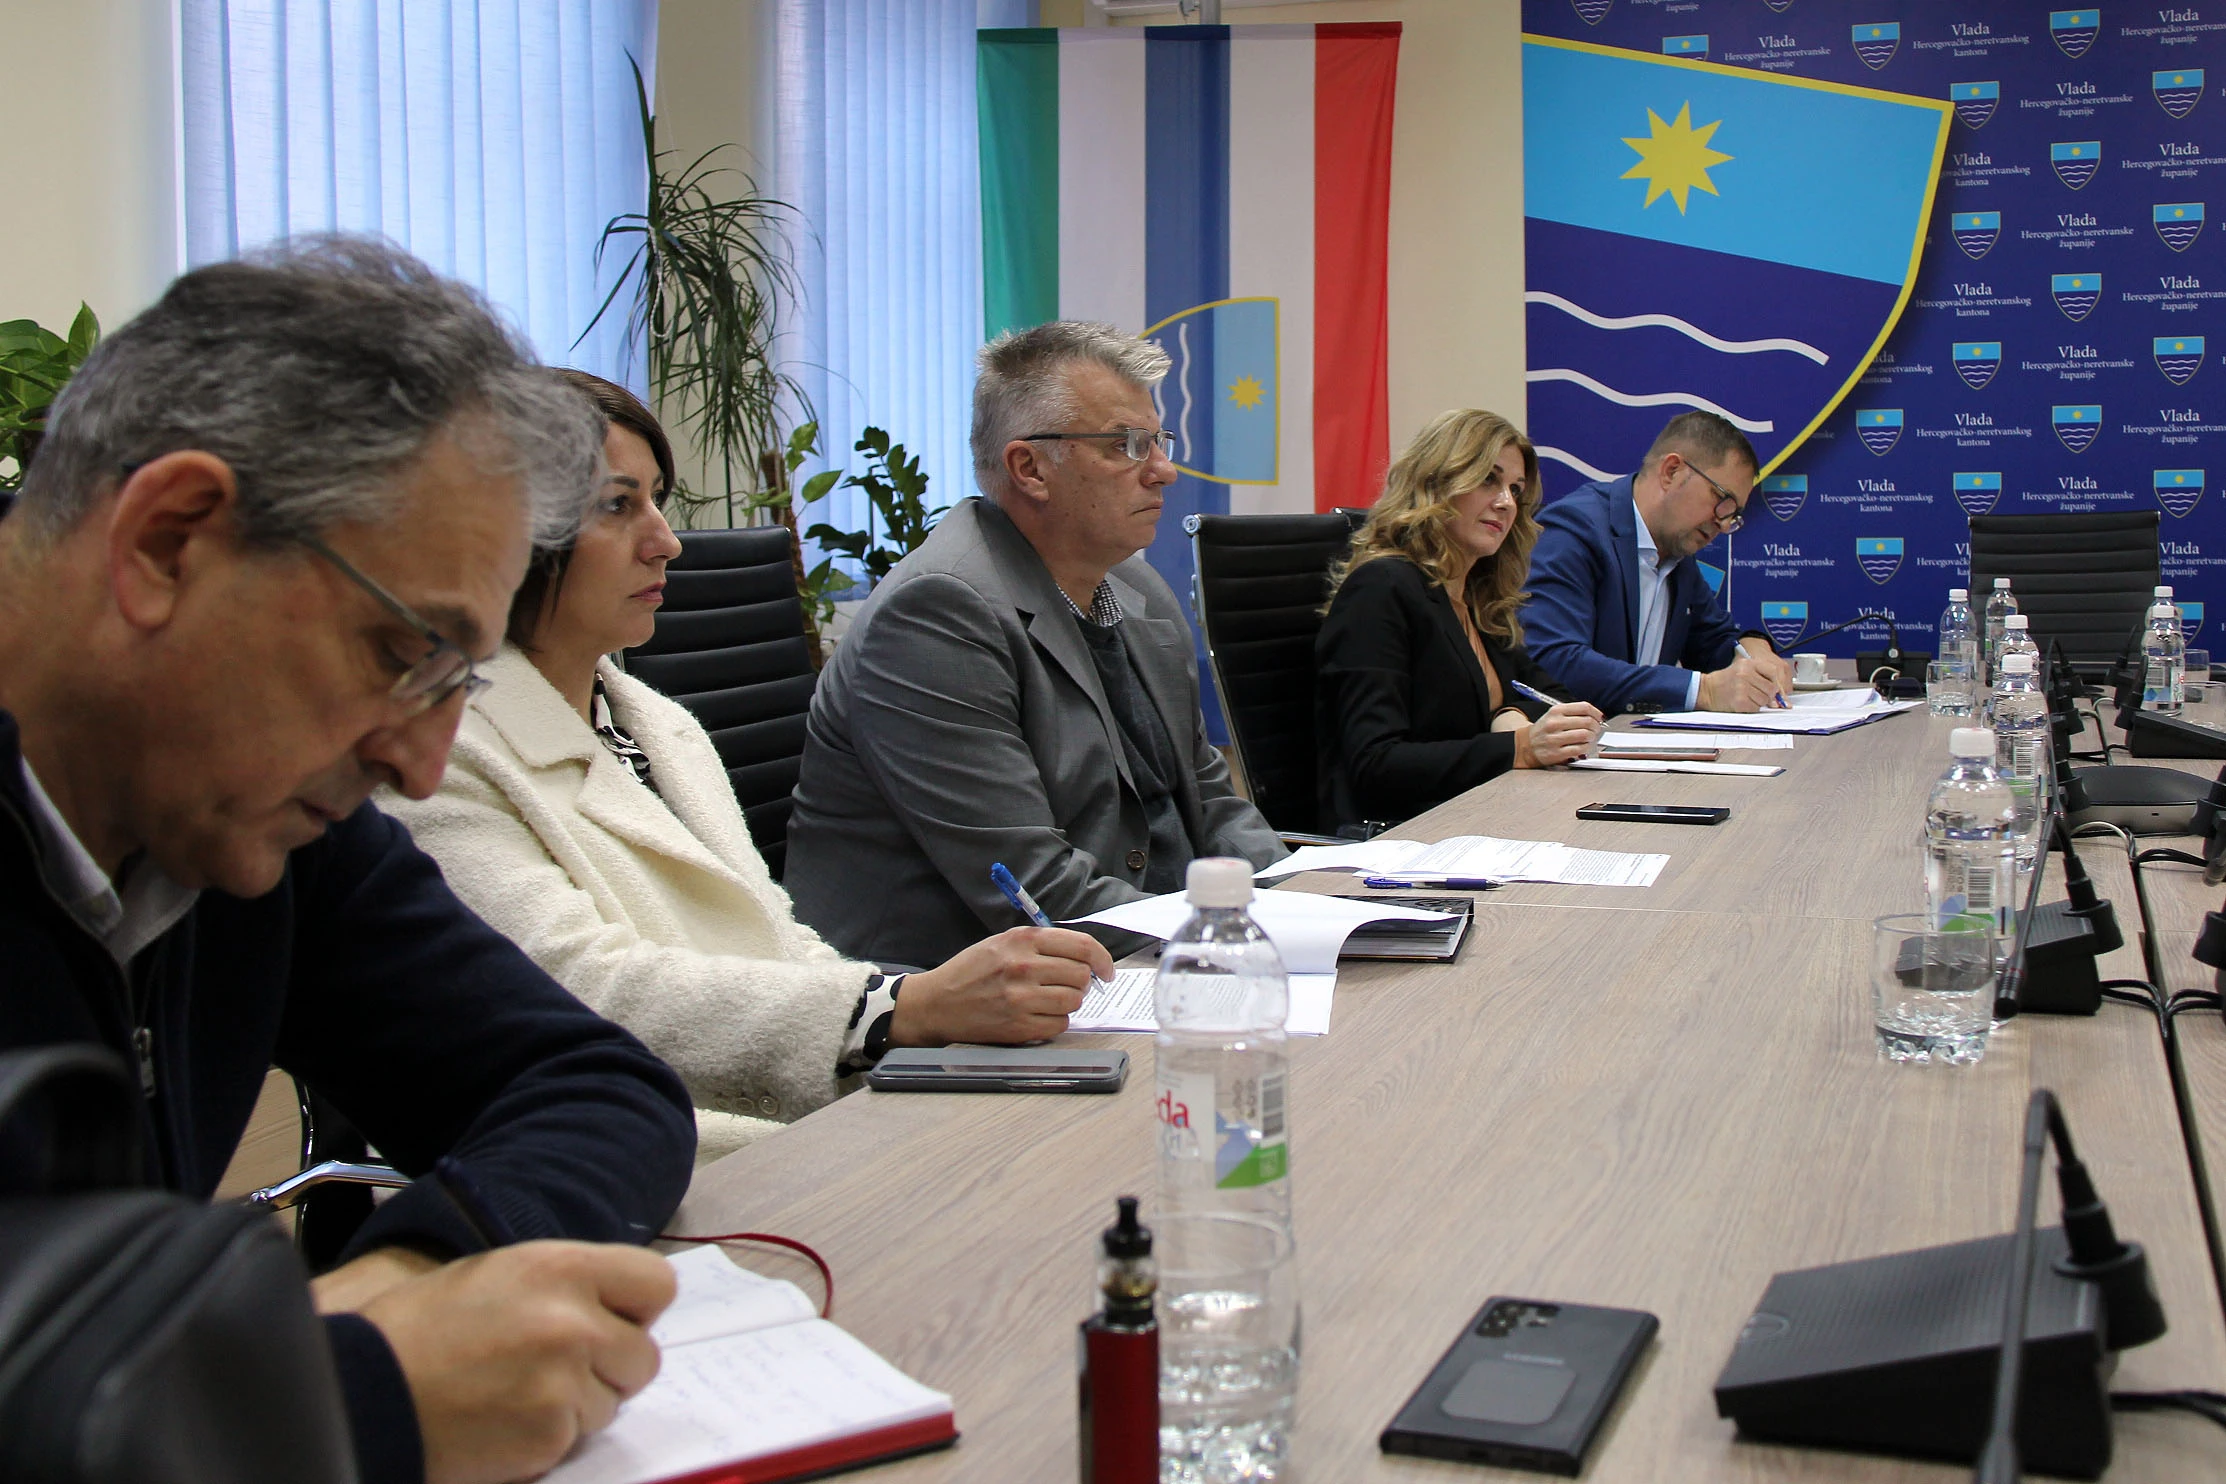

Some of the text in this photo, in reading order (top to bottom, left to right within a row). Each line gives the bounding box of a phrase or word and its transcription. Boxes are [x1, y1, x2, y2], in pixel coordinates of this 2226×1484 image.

[2159, 8, 2199, 22] Vlada
[1951, 22, 1990, 36] Vlada
[1758, 34, 1796, 48] Vlada
[2056, 81, 2096, 95] Vlada
[2159, 142, 2200, 156] Vlada
[1953, 152, 1991, 166] Vlada
[2057, 213, 2097, 227] Vlada
[2020, 227, 2134, 240] Hercegovačko-neretvanske
[1953, 282, 1993, 296] Vlada
[2160, 275, 2200, 289] Vlada
[1916, 296, 2032, 310] Hercegovačko-neretvanskog
[1956, 308, 1990, 317] kantona
[2058, 344, 2098, 358] Vlada
[2022, 358, 2135, 372] Hercegovačko-neretvanske
[1954, 412, 1993, 426] Vlada
[2160, 408, 2200, 422] Vlada
[1916, 426, 2032, 439] Hercegovačko-neretvanskog
[1956, 438, 1991, 447] kantona
[1858, 478, 1896, 492] Vlada
[2058, 476, 2098, 490] Vlada
[1820, 492, 1934, 504] Hercegovačko-neretvanskog
[2022, 490, 2135, 503] Hercegovačko-neretvanske
[1860, 504, 1893, 512] kantona
[1763, 543, 1801, 556] Vlada
[2160, 541, 2200, 555] Vlada
[1860, 632, 1891, 640] kanton
